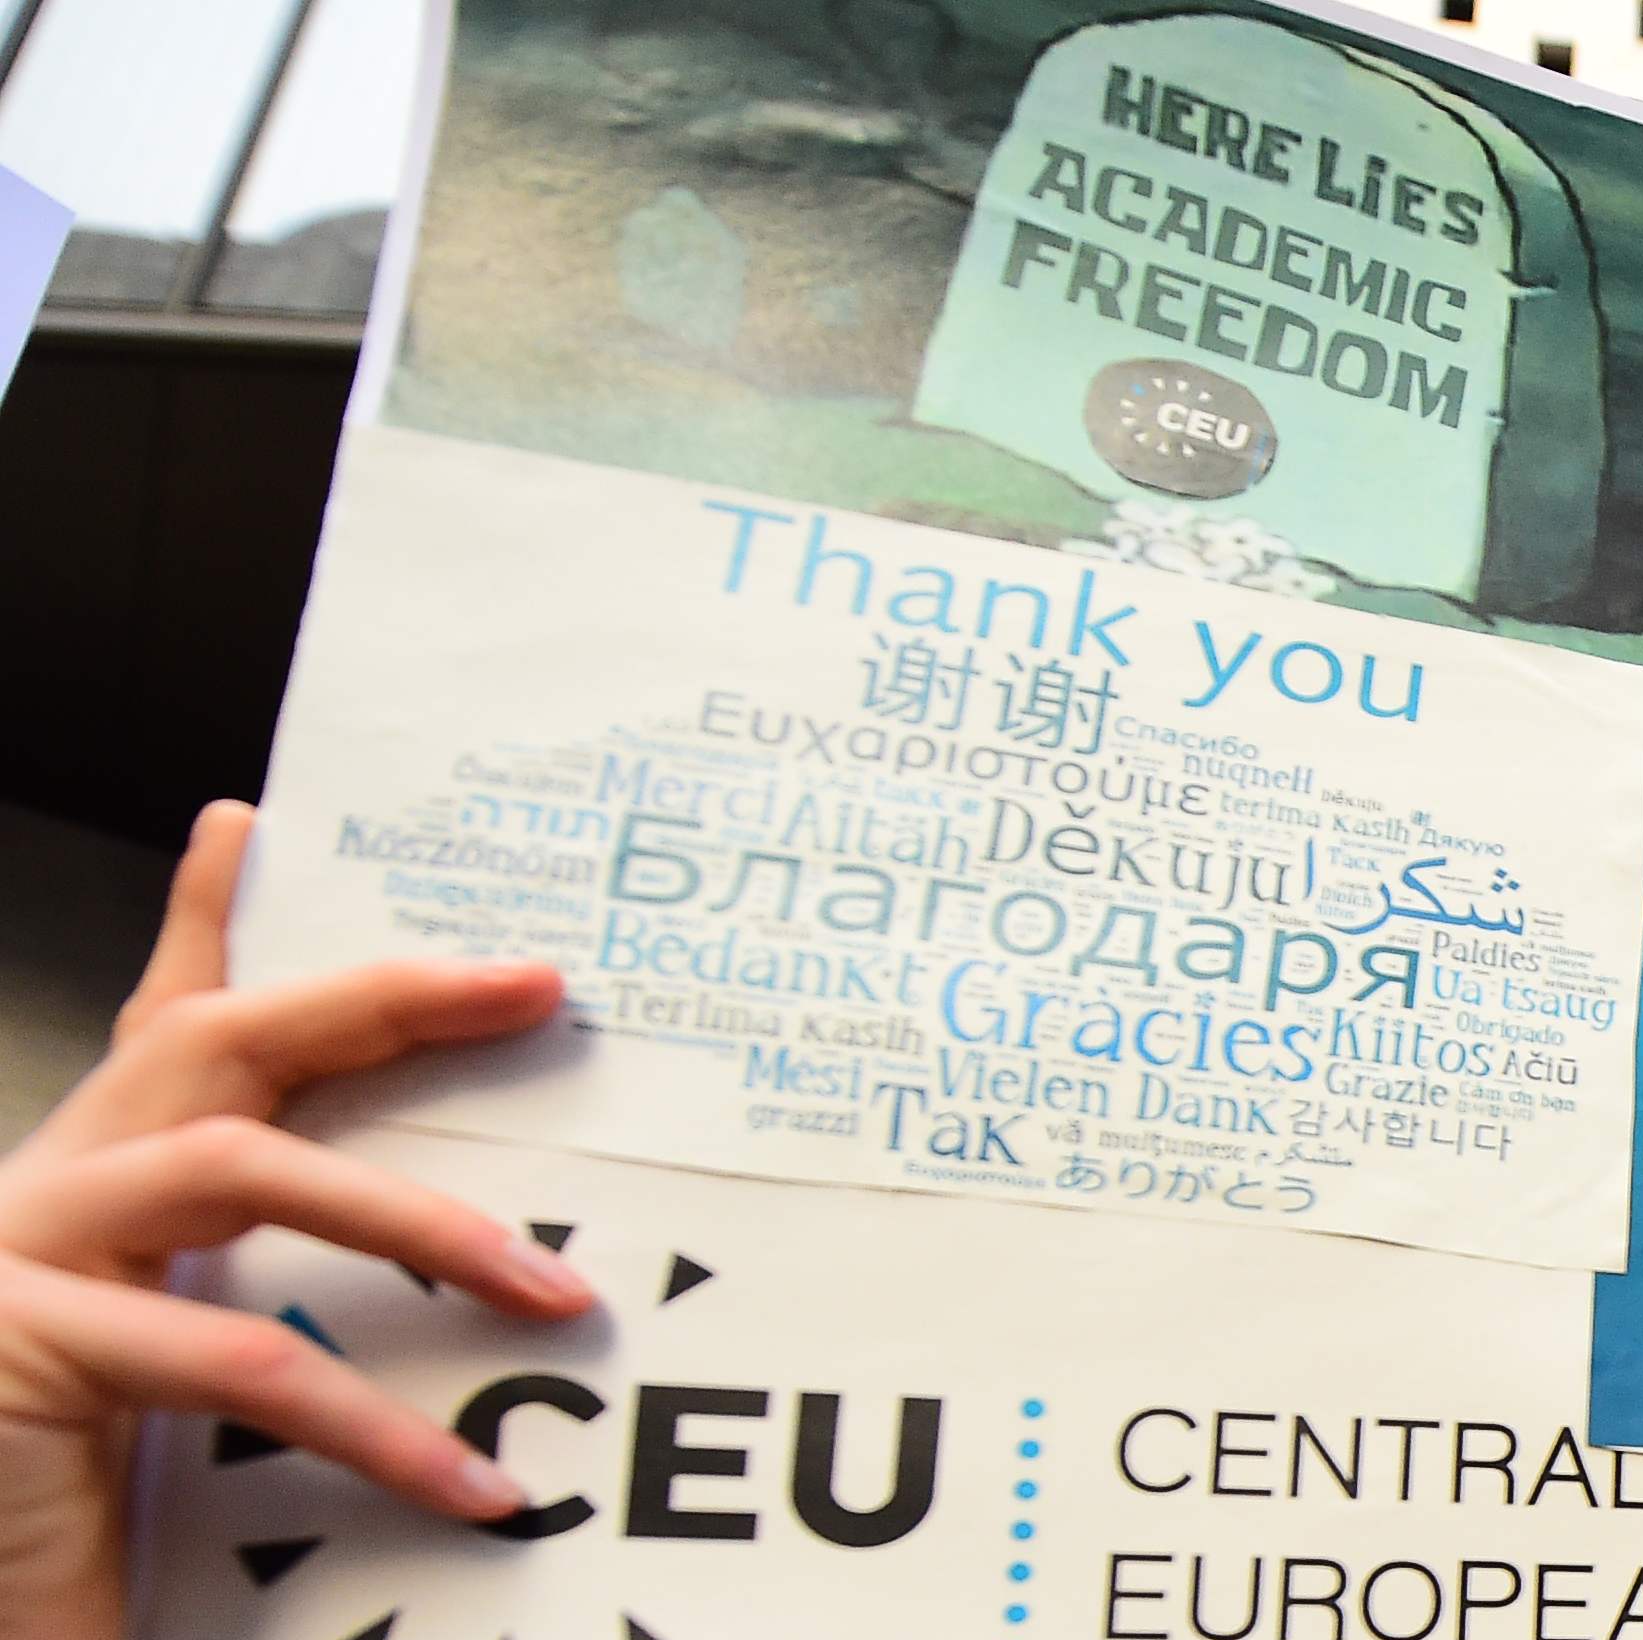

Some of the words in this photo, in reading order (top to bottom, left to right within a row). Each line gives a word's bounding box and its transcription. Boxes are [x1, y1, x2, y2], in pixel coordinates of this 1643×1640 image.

[1101, 64, 1300, 185] HERE
[1028, 141, 1469, 345] ACADEMIC
[1000, 219, 1469, 430] FREEDOM
[1157, 401, 1252, 452] CEU
[701, 499, 1138, 669] Thank
[1182, 618, 1423, 723] you
[858, 631, 1121, 757] 谢谢
[1114, 713, 1262, 762] Спасибо
[596, 752, 776, 825] Merci
[605, 811, 1420, 1012] Благодаря
[1431, 930, 1542, 973] Paldies
[598, 909, 927, 1007] Bedankt
[611, 978, 782, 1038] Terima
[1327, 1007, 1495, 1078] Kiitos
[1456, 1010, 1566, 1046] Obrigado
[872, 1080, 1028, 1167] Tak
[937, 1046, 1109, 1119] Vielen
[1135, 1071, 1279, 1137] Dank
[1325, 1061, 1448, 1107] Grazie
[1287, 1098, 1513, 1161] 감사합니다
[1055, 1152, 1318, 1212] ありがとう
[453, 1373, 944, 1548] CEU
